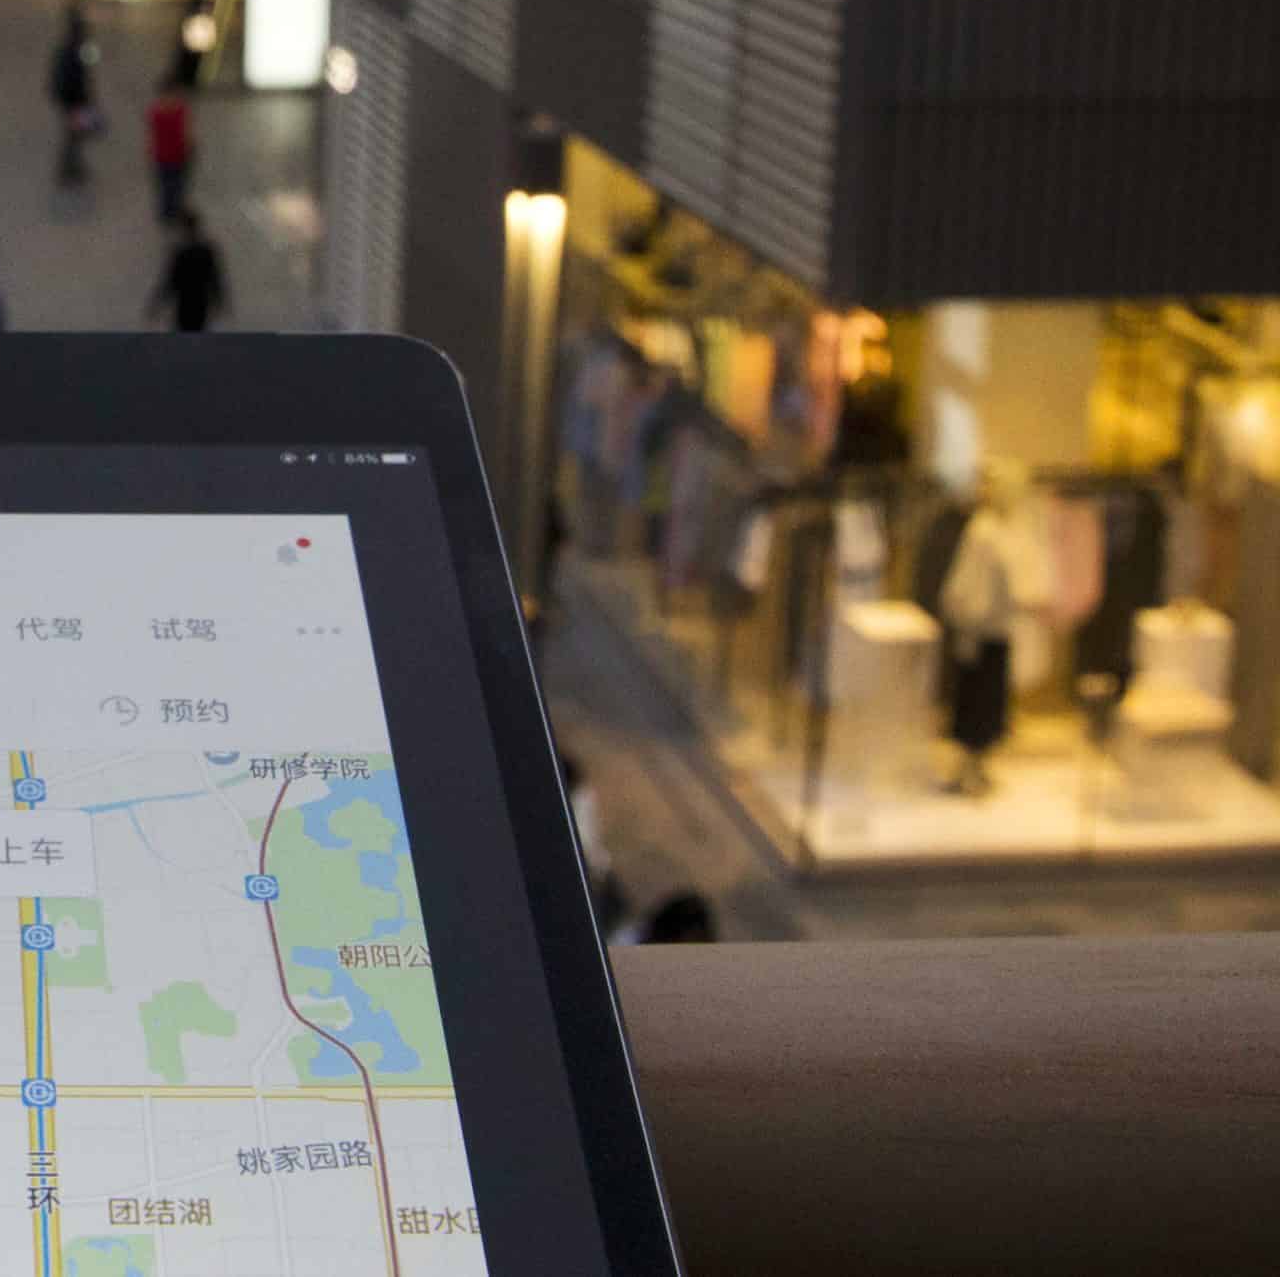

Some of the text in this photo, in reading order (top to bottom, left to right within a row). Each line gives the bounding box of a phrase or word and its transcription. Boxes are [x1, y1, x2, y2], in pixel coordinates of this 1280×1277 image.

[15, 617, 83, 641] 代驾
[151, 618, 217, 642] 试驾
[159, 698, 230, 723] 预约
[249, 756, 372, 781] 研修学院
[237, 1139, 374, 1176] 姚家园路
[26, 1151, 60, 1214] 三环
[107, 1197, 213, 1226] 团结湖
